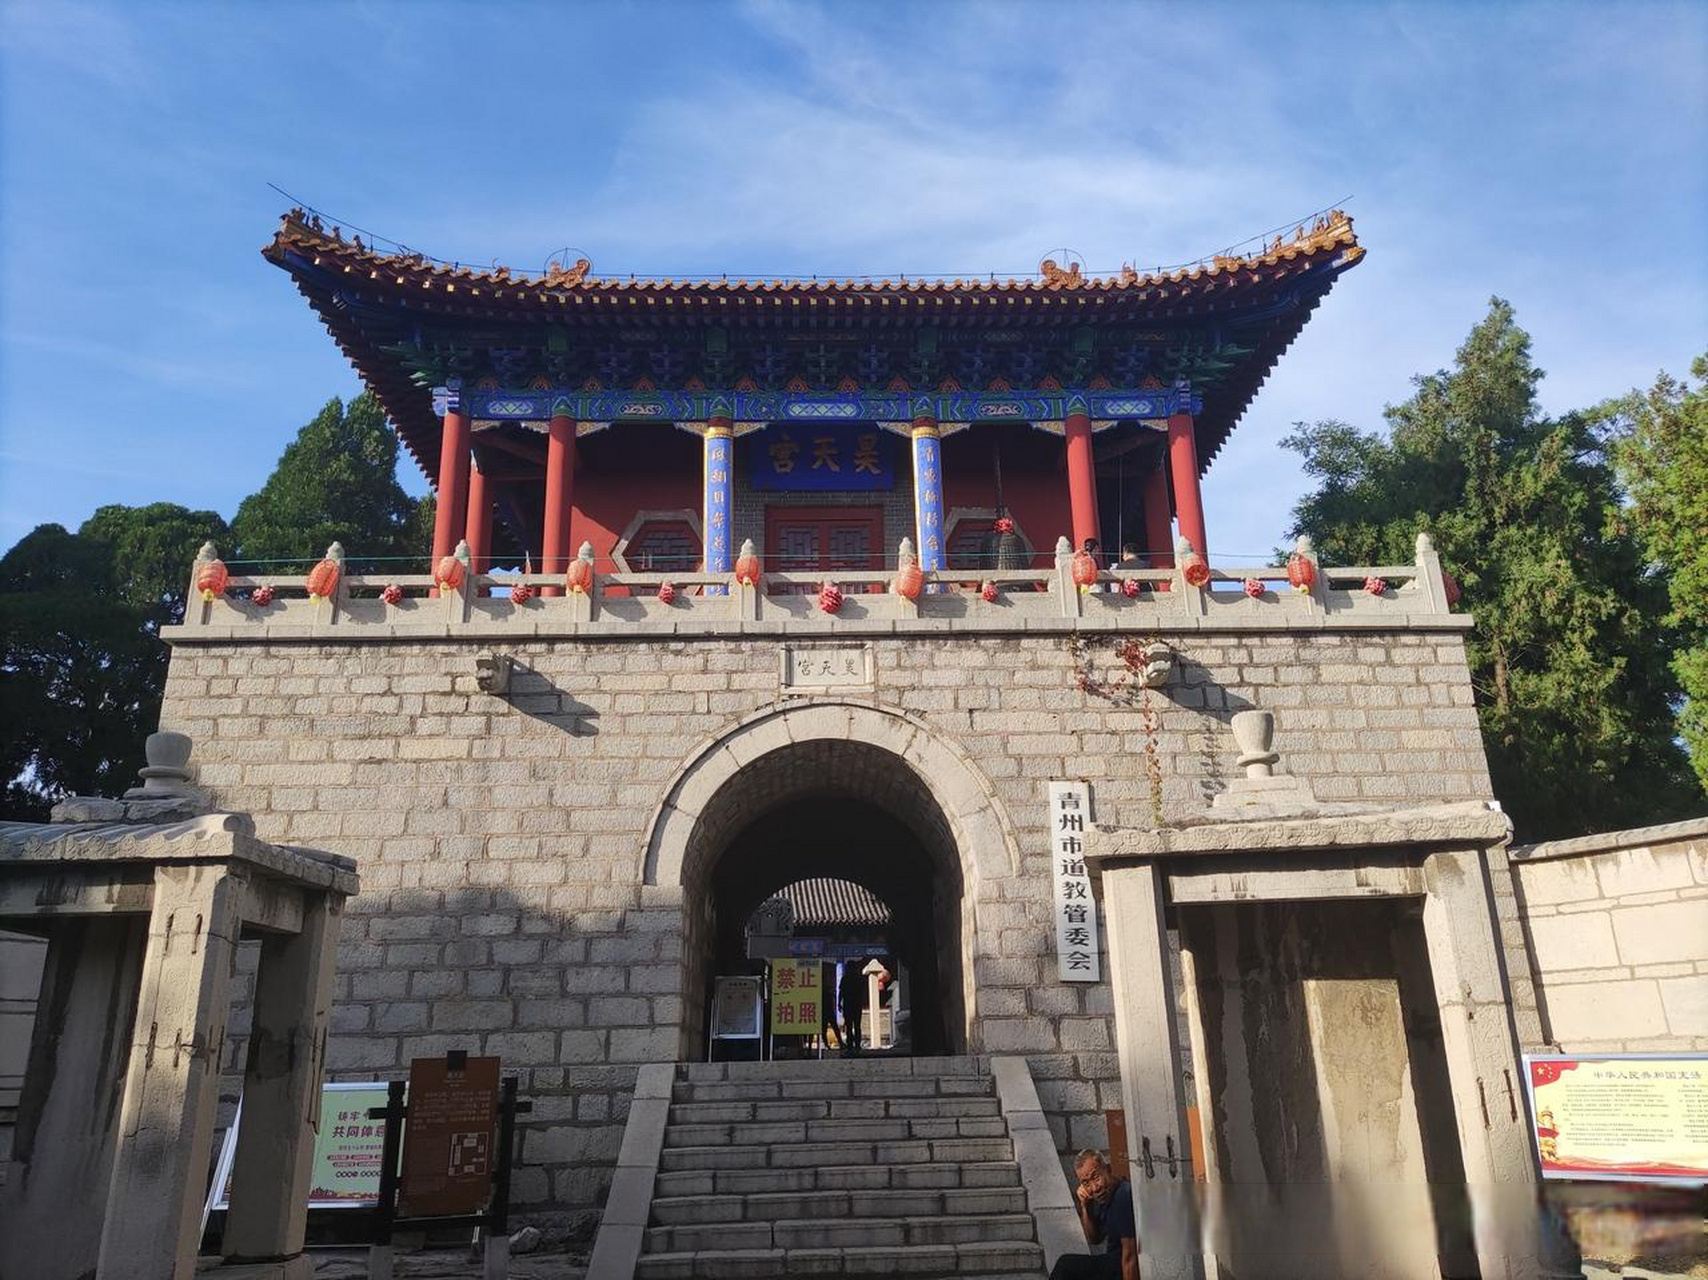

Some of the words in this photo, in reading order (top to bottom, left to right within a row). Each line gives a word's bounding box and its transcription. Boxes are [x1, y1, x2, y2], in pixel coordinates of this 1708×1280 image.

[1057, 791, 1091, 971] 青州市道教管委会
[776, 967, 818, 990] 禁止
[776, 1001, 818, 1025] 拍照
